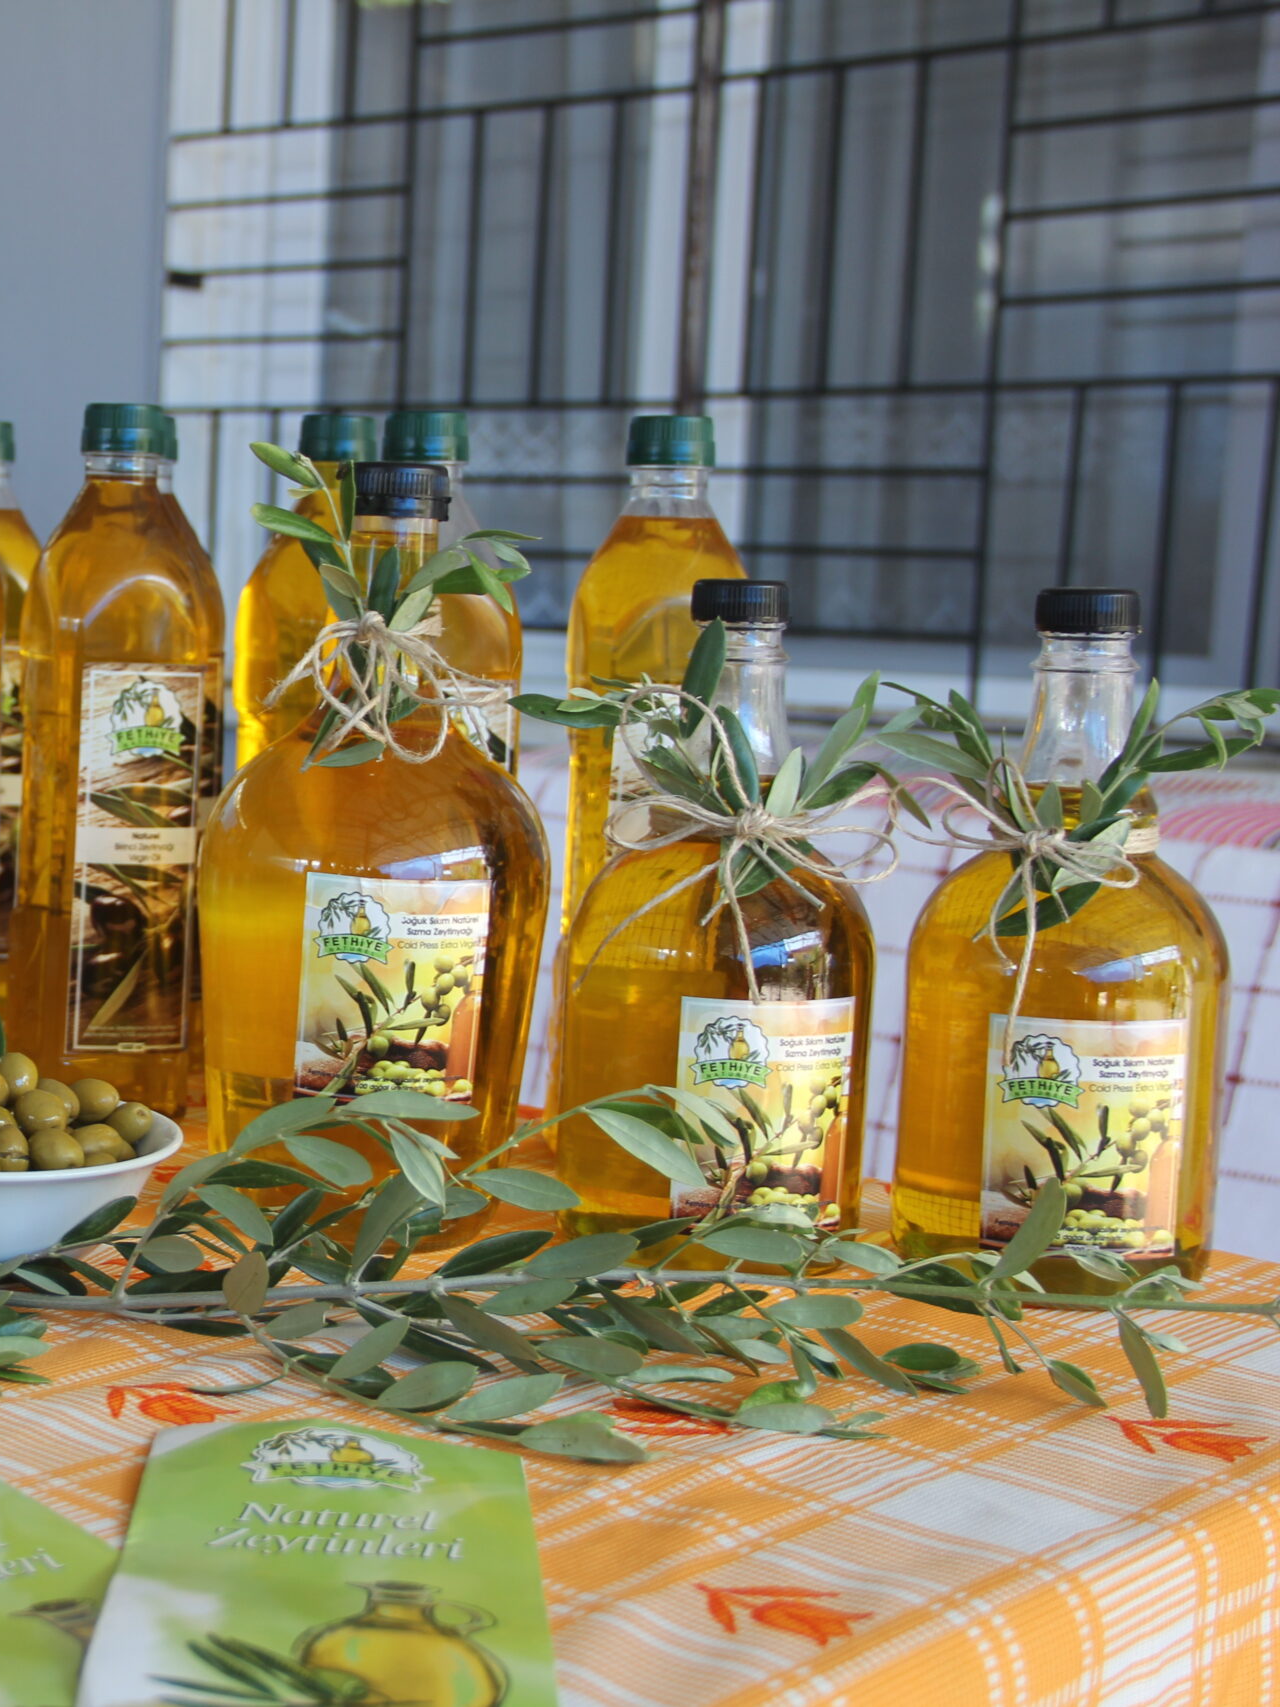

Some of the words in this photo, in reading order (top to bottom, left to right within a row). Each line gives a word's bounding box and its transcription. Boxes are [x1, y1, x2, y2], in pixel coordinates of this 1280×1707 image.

[397, 941, 418, 949] Cold
[420, 941, 438, 949] Press
[776, 1063, 795, 1072] Cold
[1092, 1058, 1121, 1068] Soğuk
[1088, 1083, 1111, 1092] Cold
[234, 1502, 437, 1532] Naturel
[207, 1526, 465, 1560] Zeytinleri
